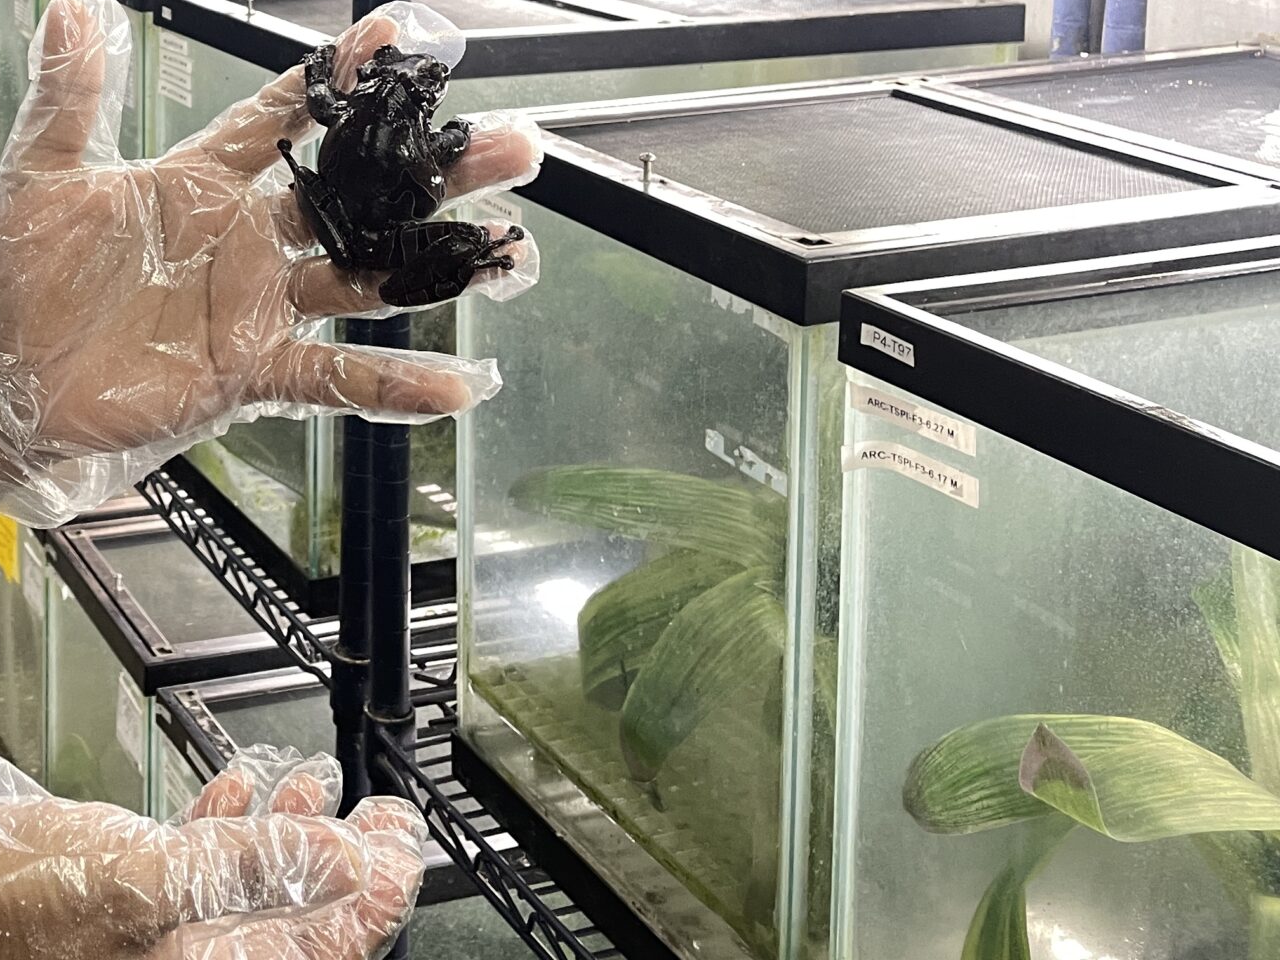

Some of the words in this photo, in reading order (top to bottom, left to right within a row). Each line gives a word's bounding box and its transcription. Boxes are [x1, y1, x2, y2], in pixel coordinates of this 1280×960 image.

[872, 330, 912, 357] P4-T97
[867, 397, 944, 434] ARC-TSPI-F3-6.27
[947, 428, 955, 438] M
[861, 450, 948, 483] ARC-TSPI-F3-6.17
[950, 478, 958, 489] M
